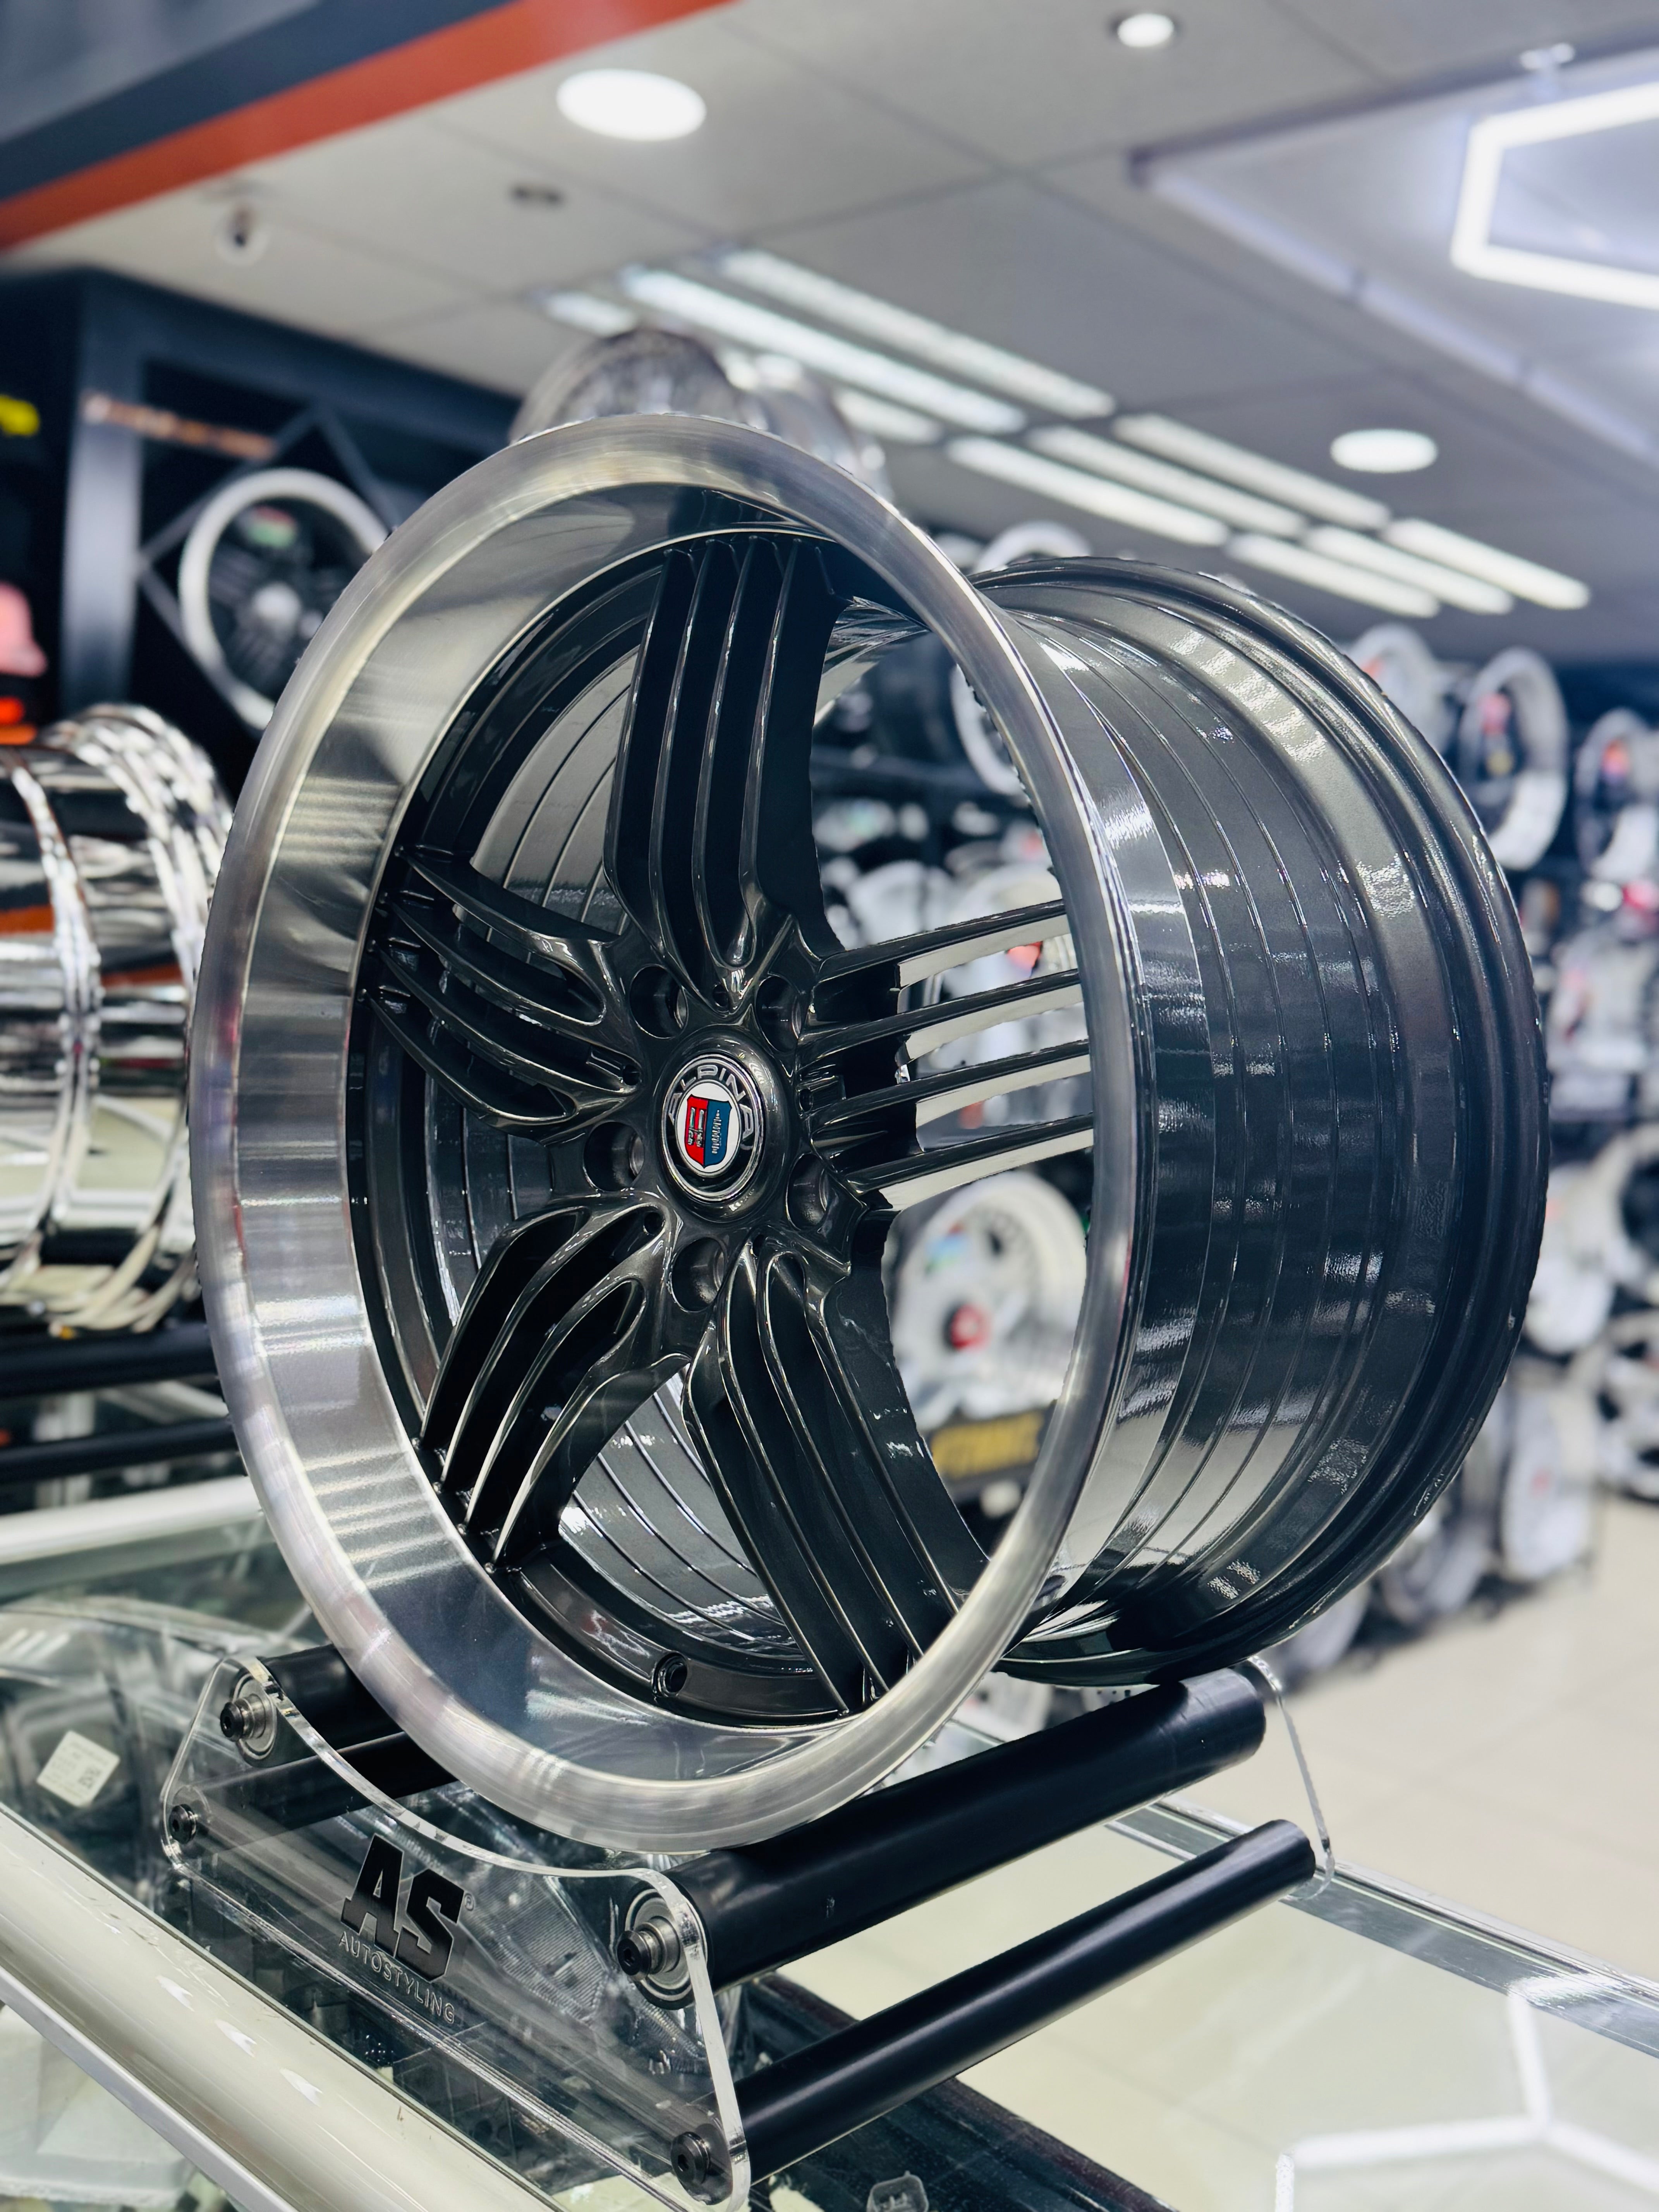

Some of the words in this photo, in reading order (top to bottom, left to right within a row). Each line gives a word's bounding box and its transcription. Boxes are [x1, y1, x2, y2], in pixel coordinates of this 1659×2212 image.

[668, 1064, 754, 1140] ALPINA
[341, 1833, 465, 1983] AS
[338, 1931, 455, 2024] AUTOSTYLING
